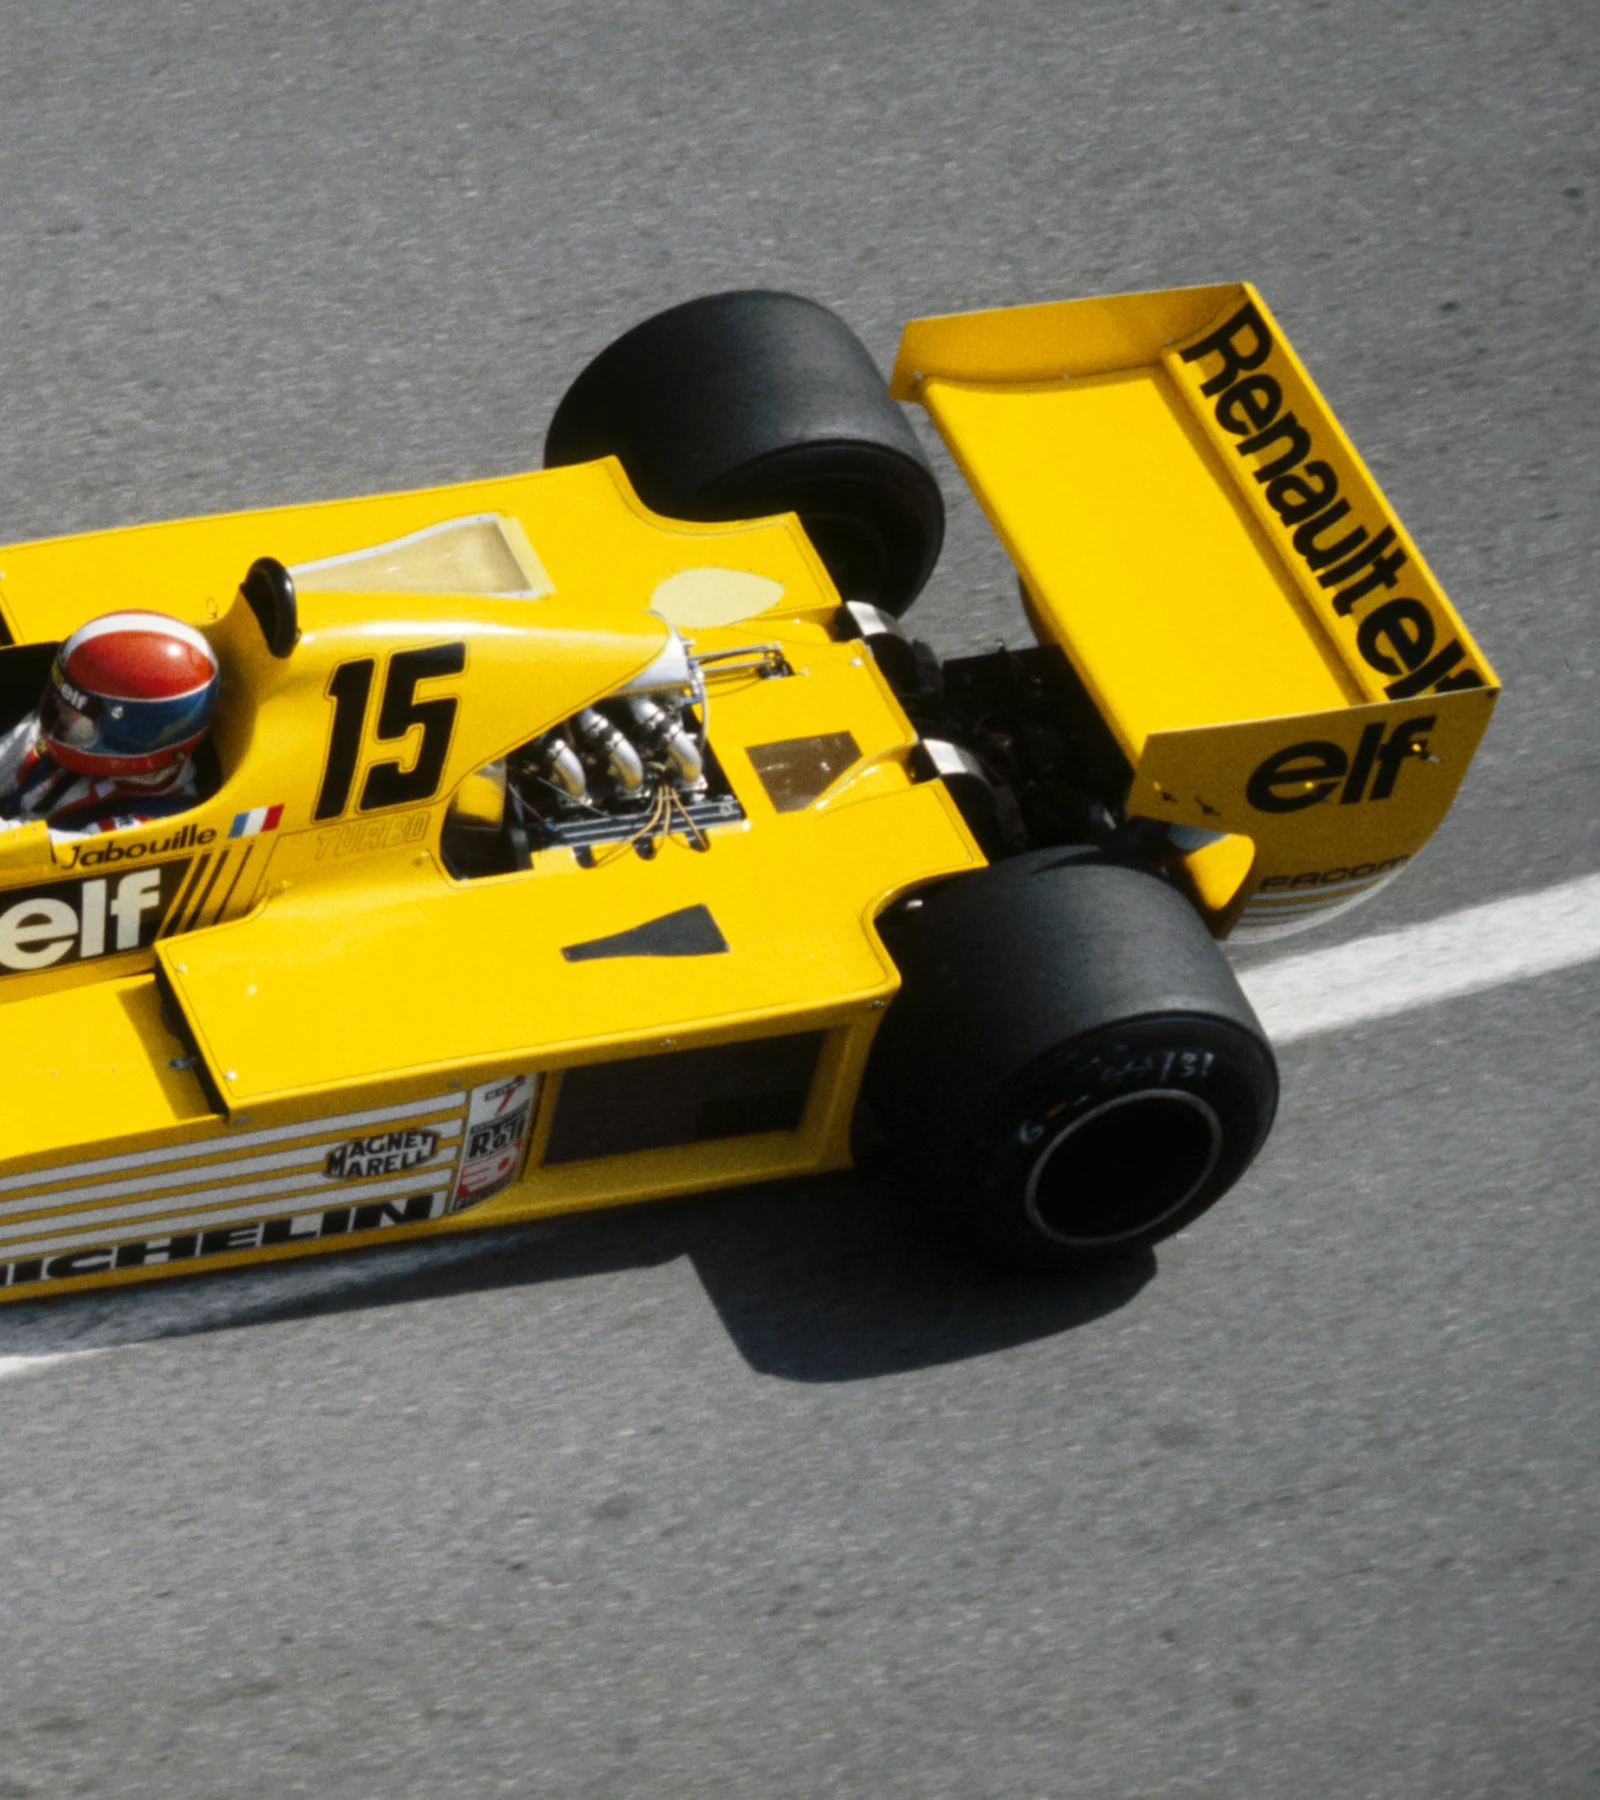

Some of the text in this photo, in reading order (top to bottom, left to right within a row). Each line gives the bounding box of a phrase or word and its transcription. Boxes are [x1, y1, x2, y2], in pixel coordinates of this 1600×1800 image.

[1181, 304, 1409, 616] Renault
[314, 641, 466, 821] 15
[1246, 714, 1437, 814] elf
[61, 824, 217, 869] Jabouille
